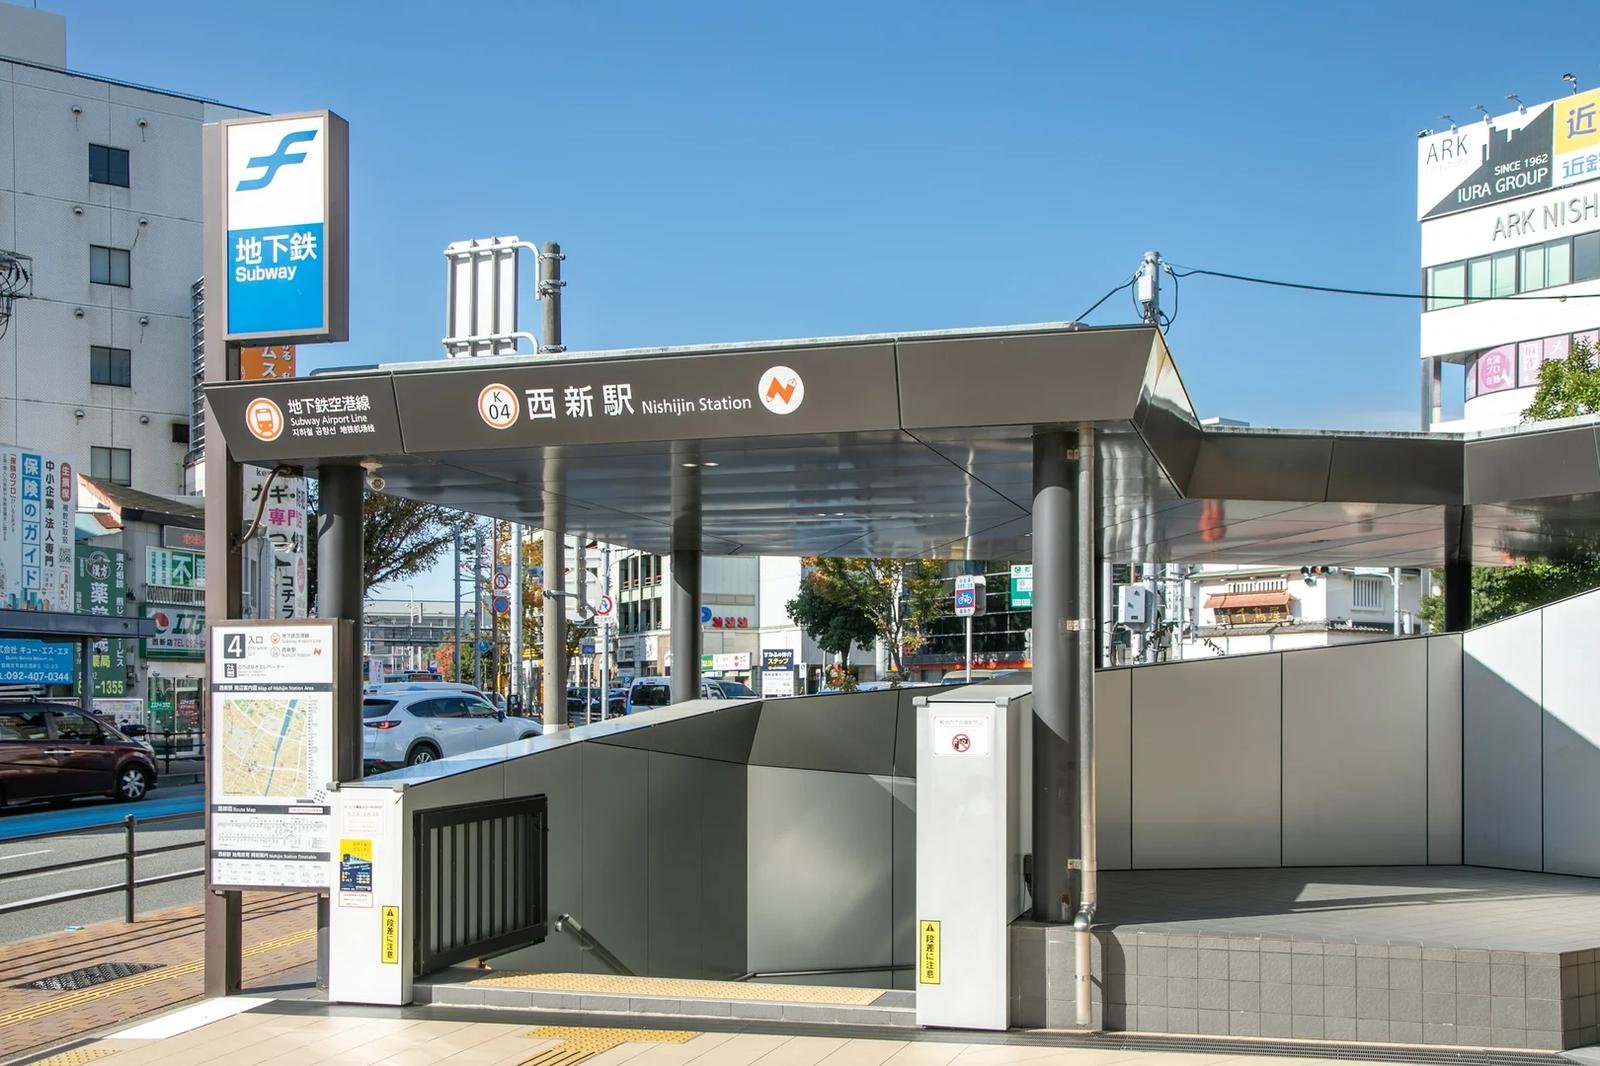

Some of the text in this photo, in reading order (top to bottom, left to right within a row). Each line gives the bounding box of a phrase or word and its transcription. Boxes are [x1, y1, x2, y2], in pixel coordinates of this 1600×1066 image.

[1426, 133, 1468, 165] ARK
[1494, 153, 1549, 176] SINCE 1962
[1457, 184, 1492, 203] IURA
[1495, 167, 1549, 194] GROUP
[1492, 207, 1536, 241] ARK
[235, 231, 318, 265] 地下鉄
[235, 265, 297, 283] Subway
[288, 394, 371, 415] 地下鉄空港線
[492, 391, 502, 403] K
[525, 383, 635, 421] 西新駅
[642, 396, 752, 417] Nishijin Station
[290, 413, 368, 427] Subway Airport Line
[488, 403, 512, 421] 04
[292, 426, 314, 437] 지하철
[316, 425, 337, 436] 공항선
[22, 454, 40, 588] 保険のガイド
[45, 460, 55, 568] 中小企業・法人専門
[281, 575, 295, 619] コチラ
[226, 635, 243, 658] 4
[248, 635, 264, 645] 入口
